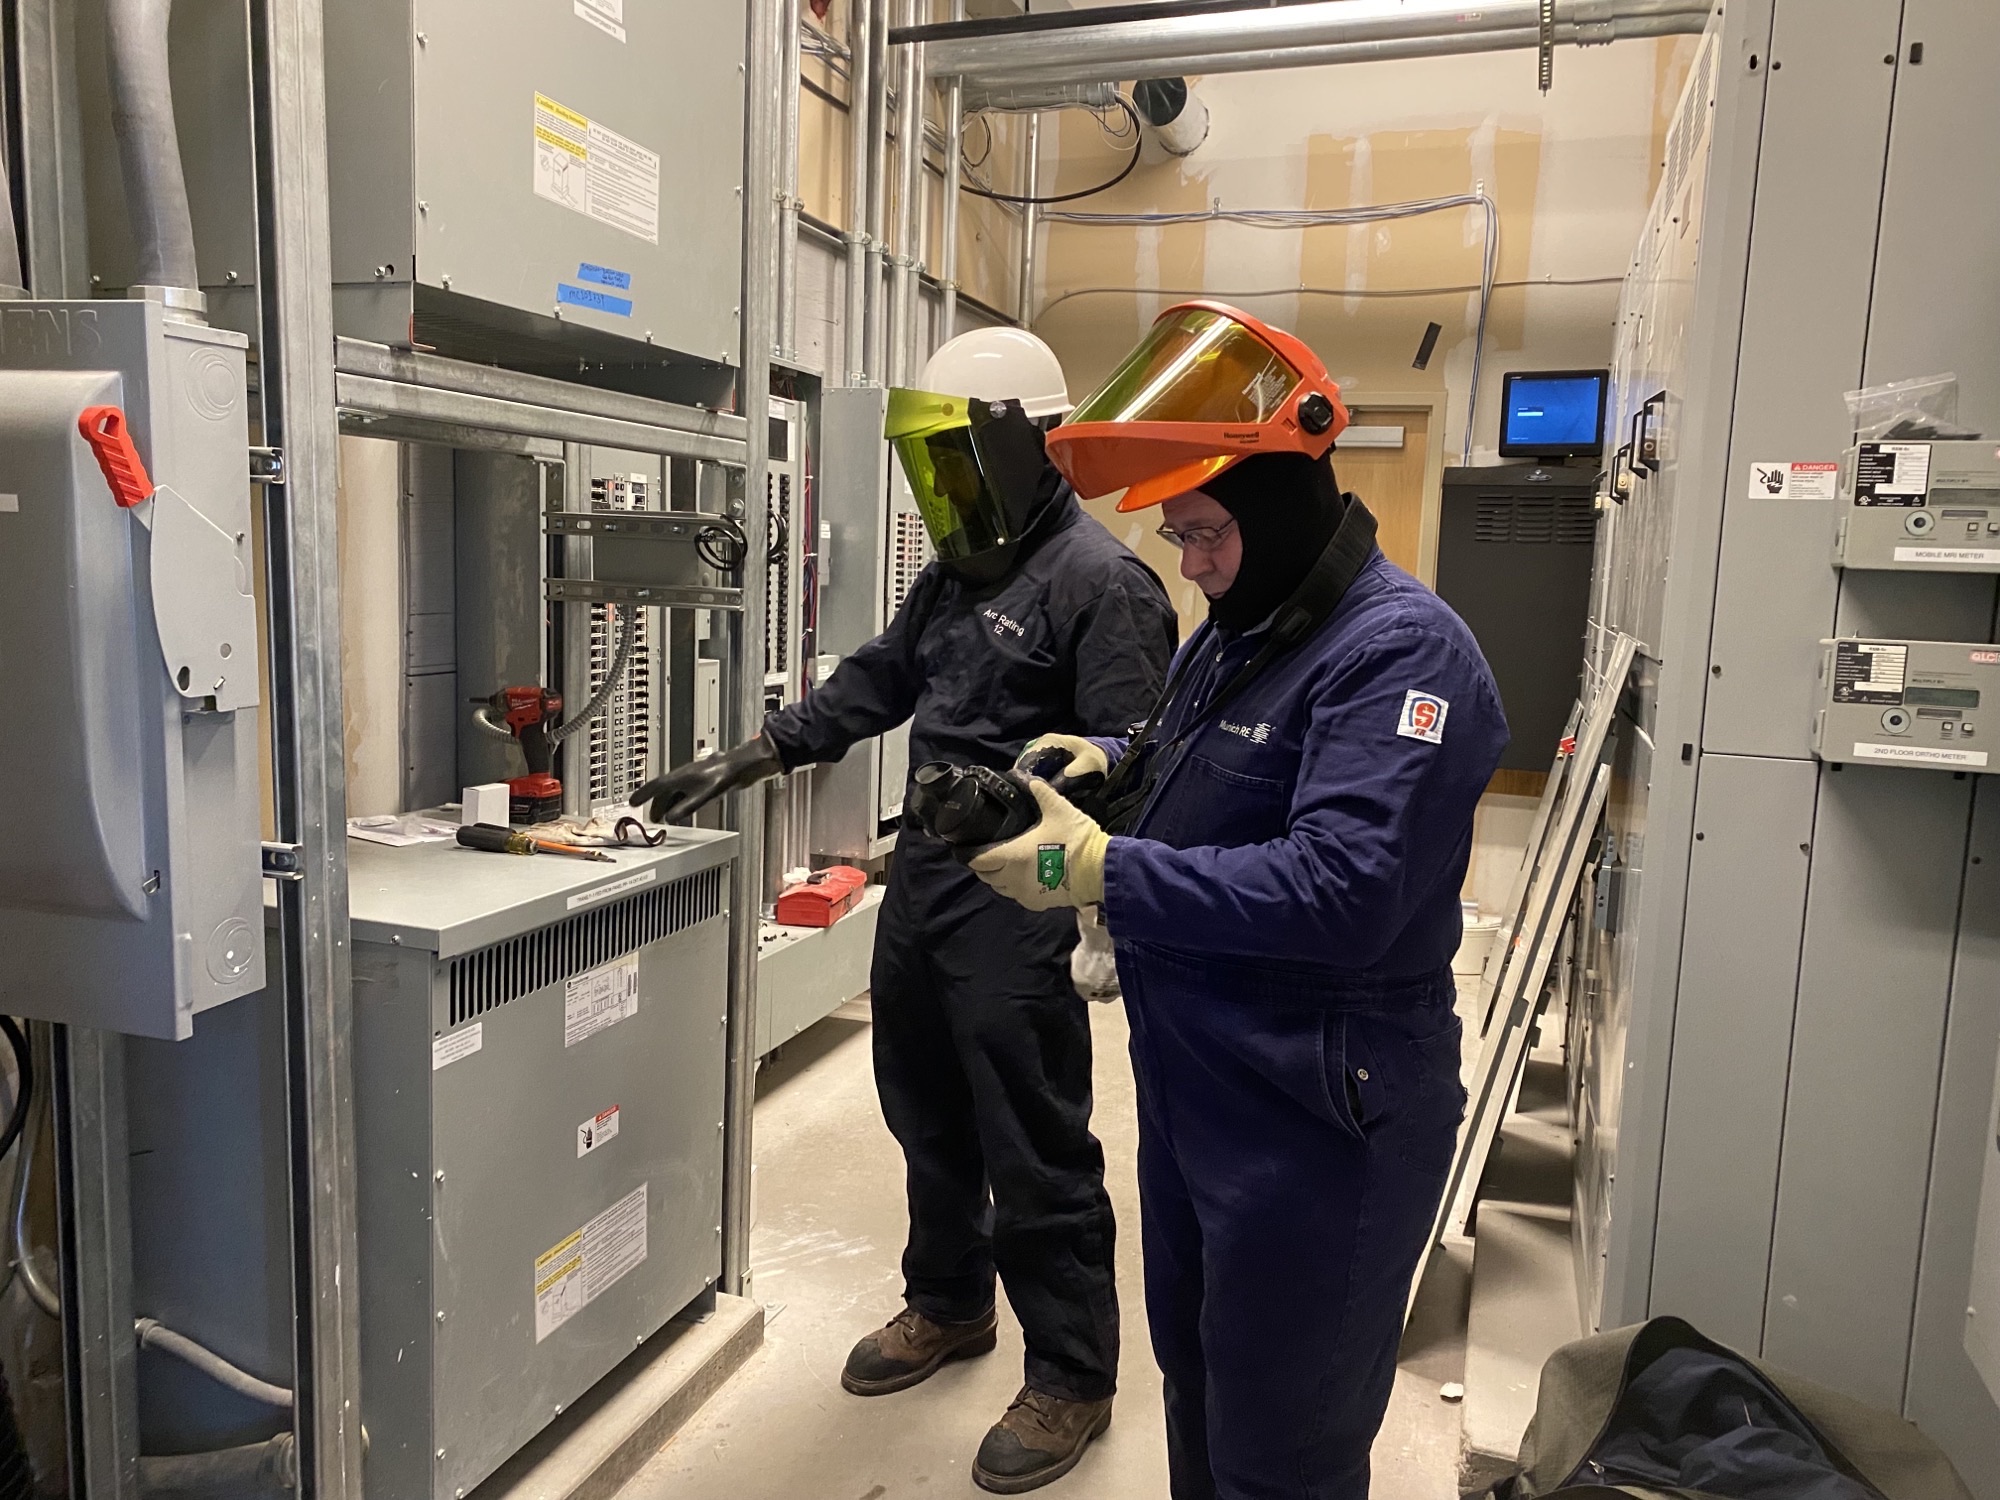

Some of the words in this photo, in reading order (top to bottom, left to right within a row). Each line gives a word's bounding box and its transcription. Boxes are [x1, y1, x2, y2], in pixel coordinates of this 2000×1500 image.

[0, 309, 101, 353] ENS
[983, 608, 998, 620] Arc
[998, 614, 1025, 637] Rating
[993, 624, 1004, 636] 12
[1218, 719, 1240, 735] Munich
[1239, 725, 1252, 738] RE
[1414, 728, 1427, 736] FR
[1890, 748, 1914, 756] FLOOR
[1915, 750, 1940, 759] ORTHO
